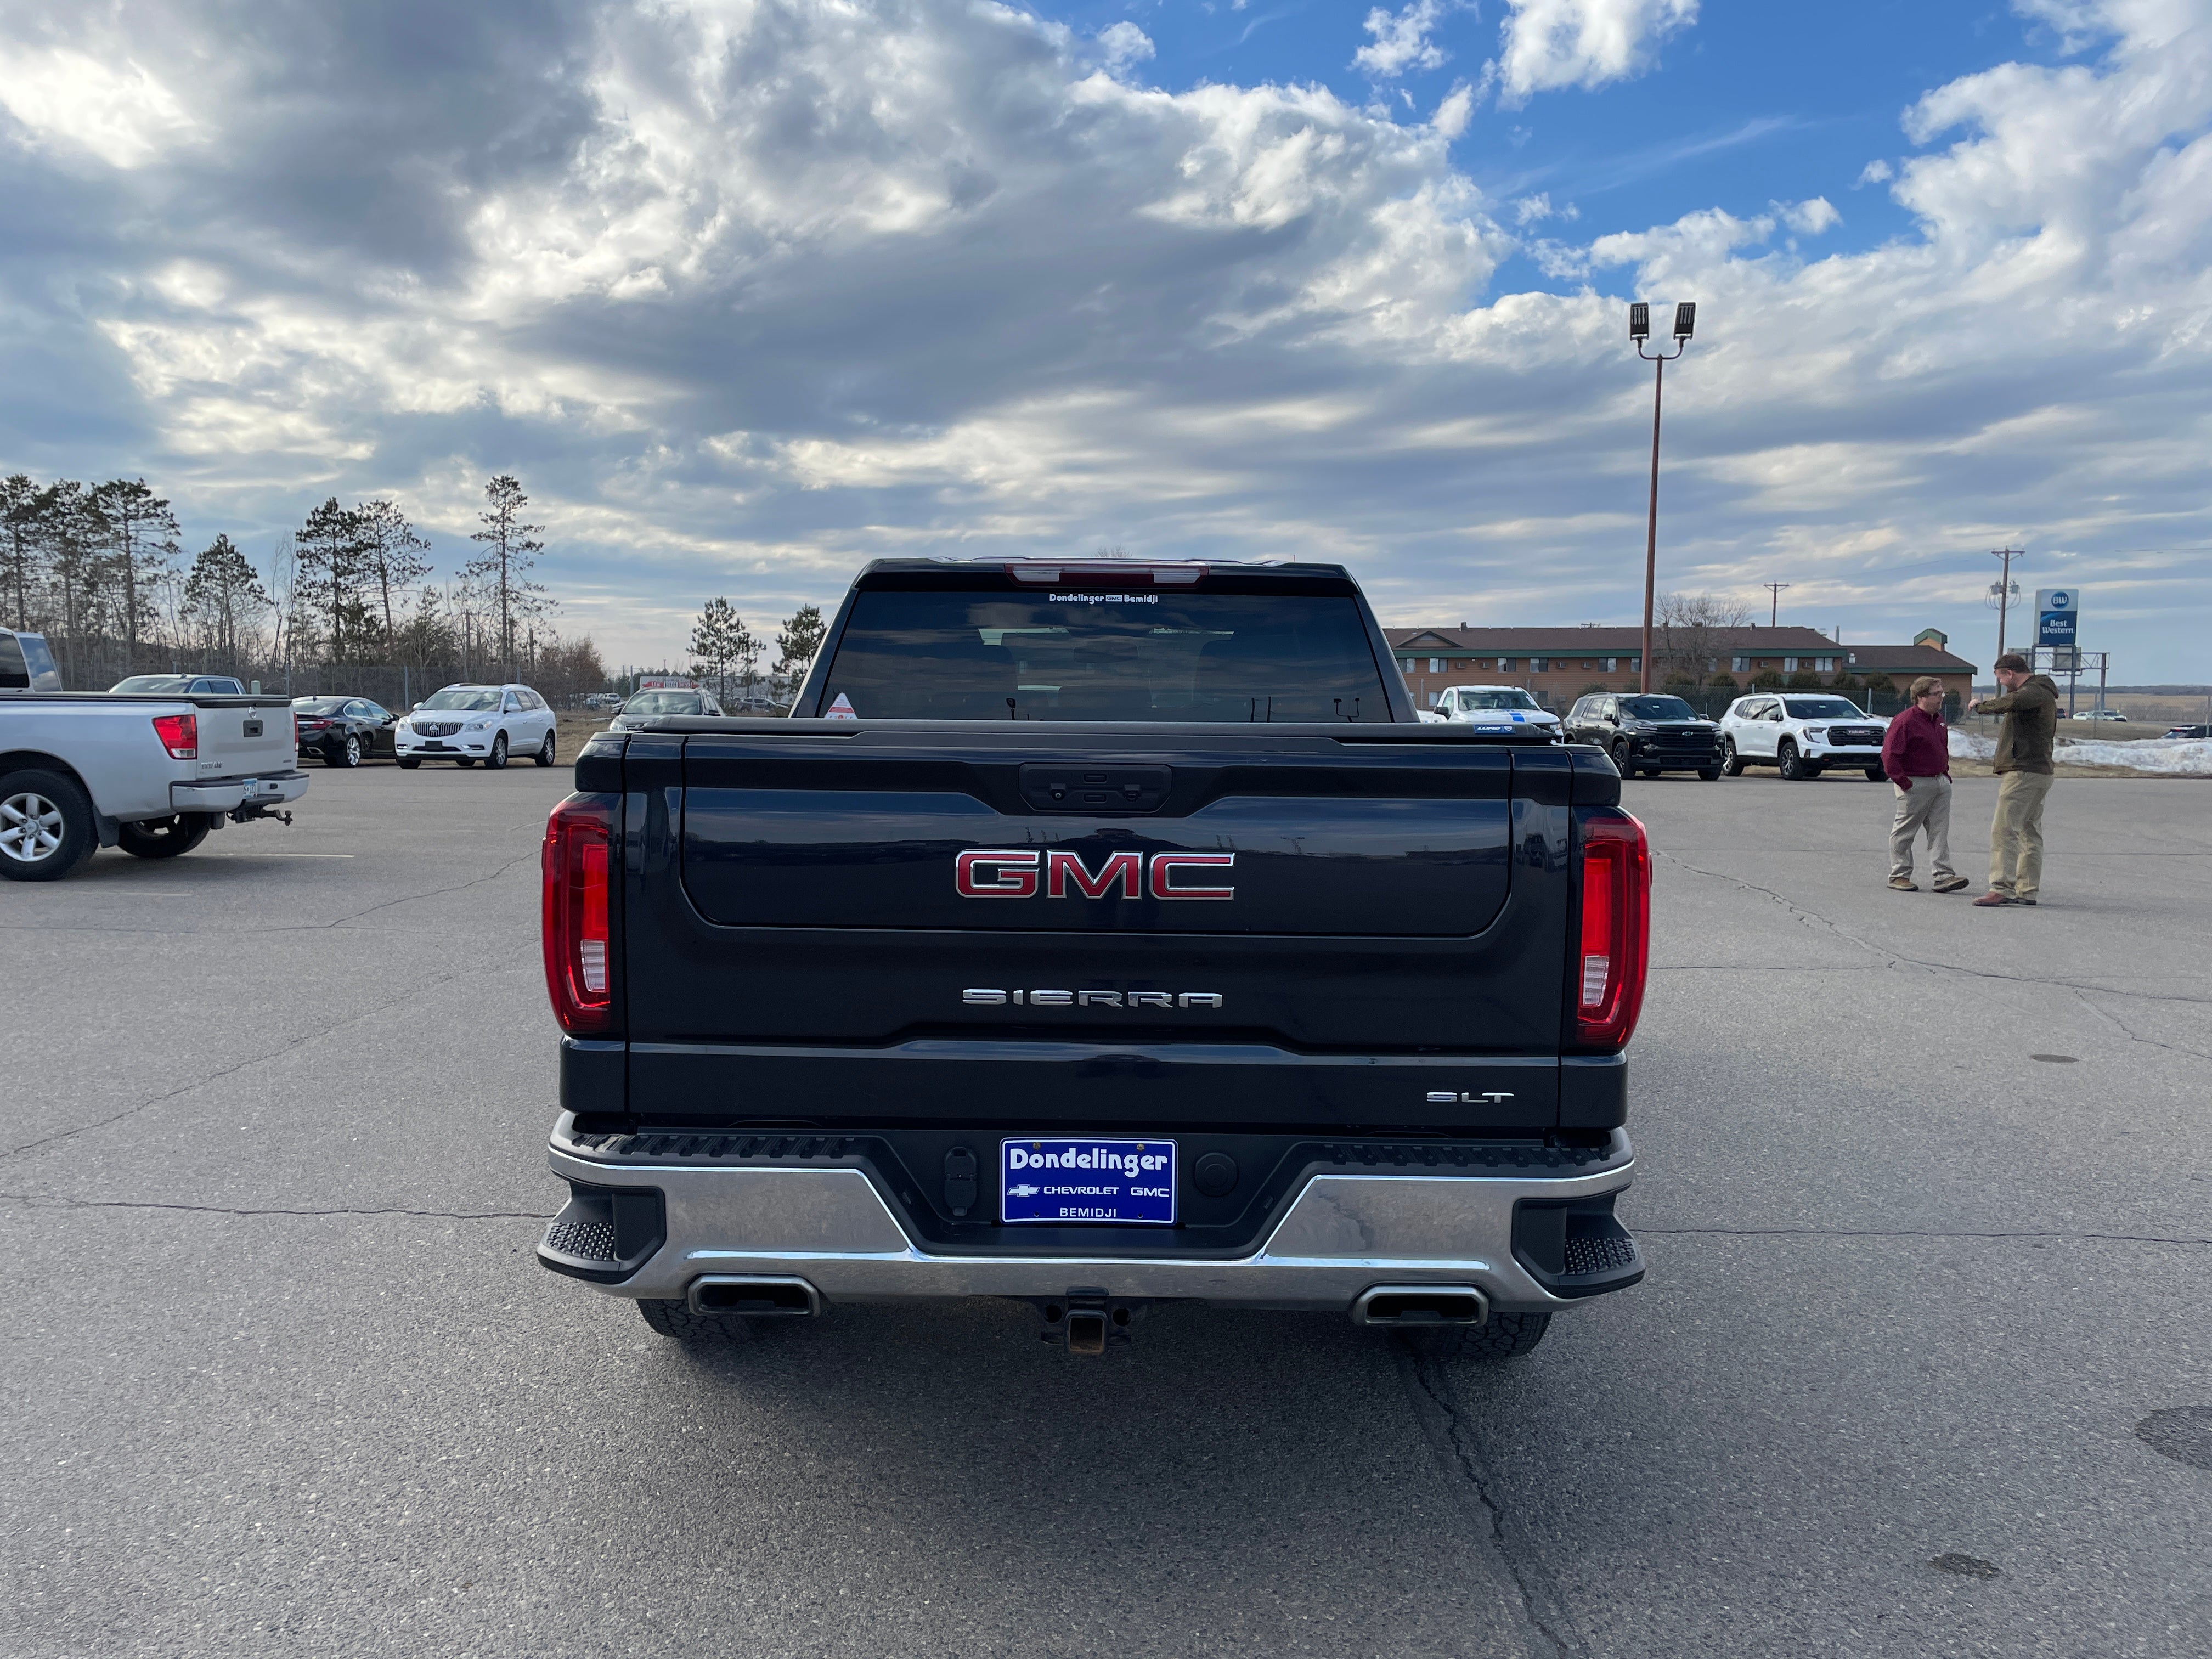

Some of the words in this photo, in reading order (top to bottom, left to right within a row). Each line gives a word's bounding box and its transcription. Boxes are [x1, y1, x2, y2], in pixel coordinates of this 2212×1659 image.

[1049, 593, 1104, 605] Dondelinger
[1124, 594, 1158, 605] Bemidji
[2053, 596, 2067, 605] BW
[955, 849, 1235, 901] GMC
[962, 989, 1223, 1009] SIERRA
[1426, 1092, 1514, 1103] SLT
[1009, 1148, 1168, 1178] Dondelinger
[1043, 1186, 1119, 1195] CHEVROLET
[1130, 1187, 1170, 1198] GMC
[1059, 1207, 1116, 1218] BEMIDJI
